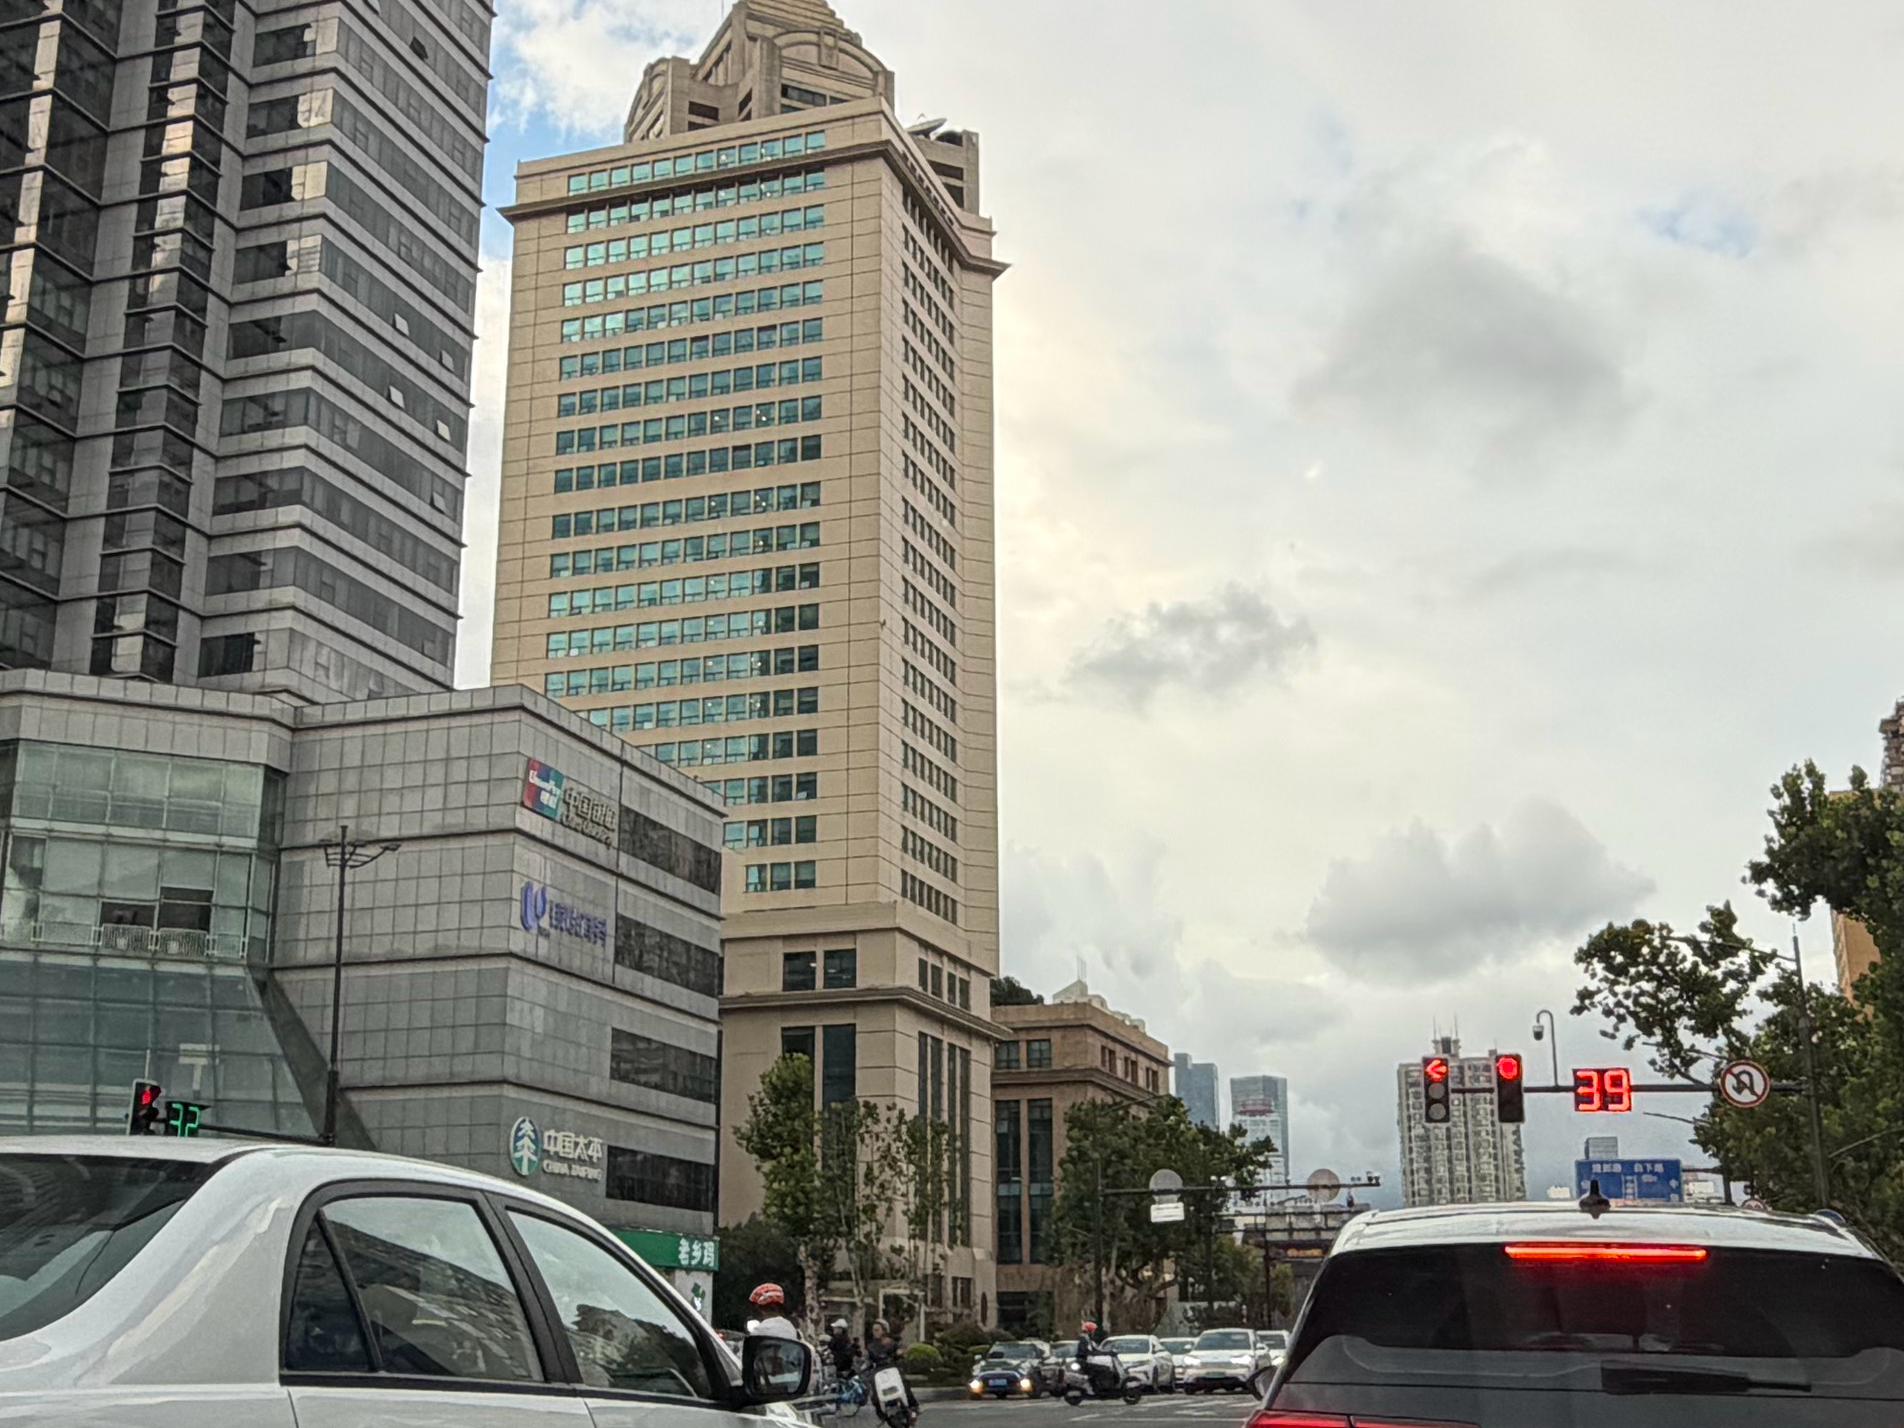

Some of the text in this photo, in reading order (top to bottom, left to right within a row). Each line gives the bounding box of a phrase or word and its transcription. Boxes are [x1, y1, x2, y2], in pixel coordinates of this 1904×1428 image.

[1575, 1069, 1632, 1111] 39
[543, 1129, 604, 1163] 中国太平
